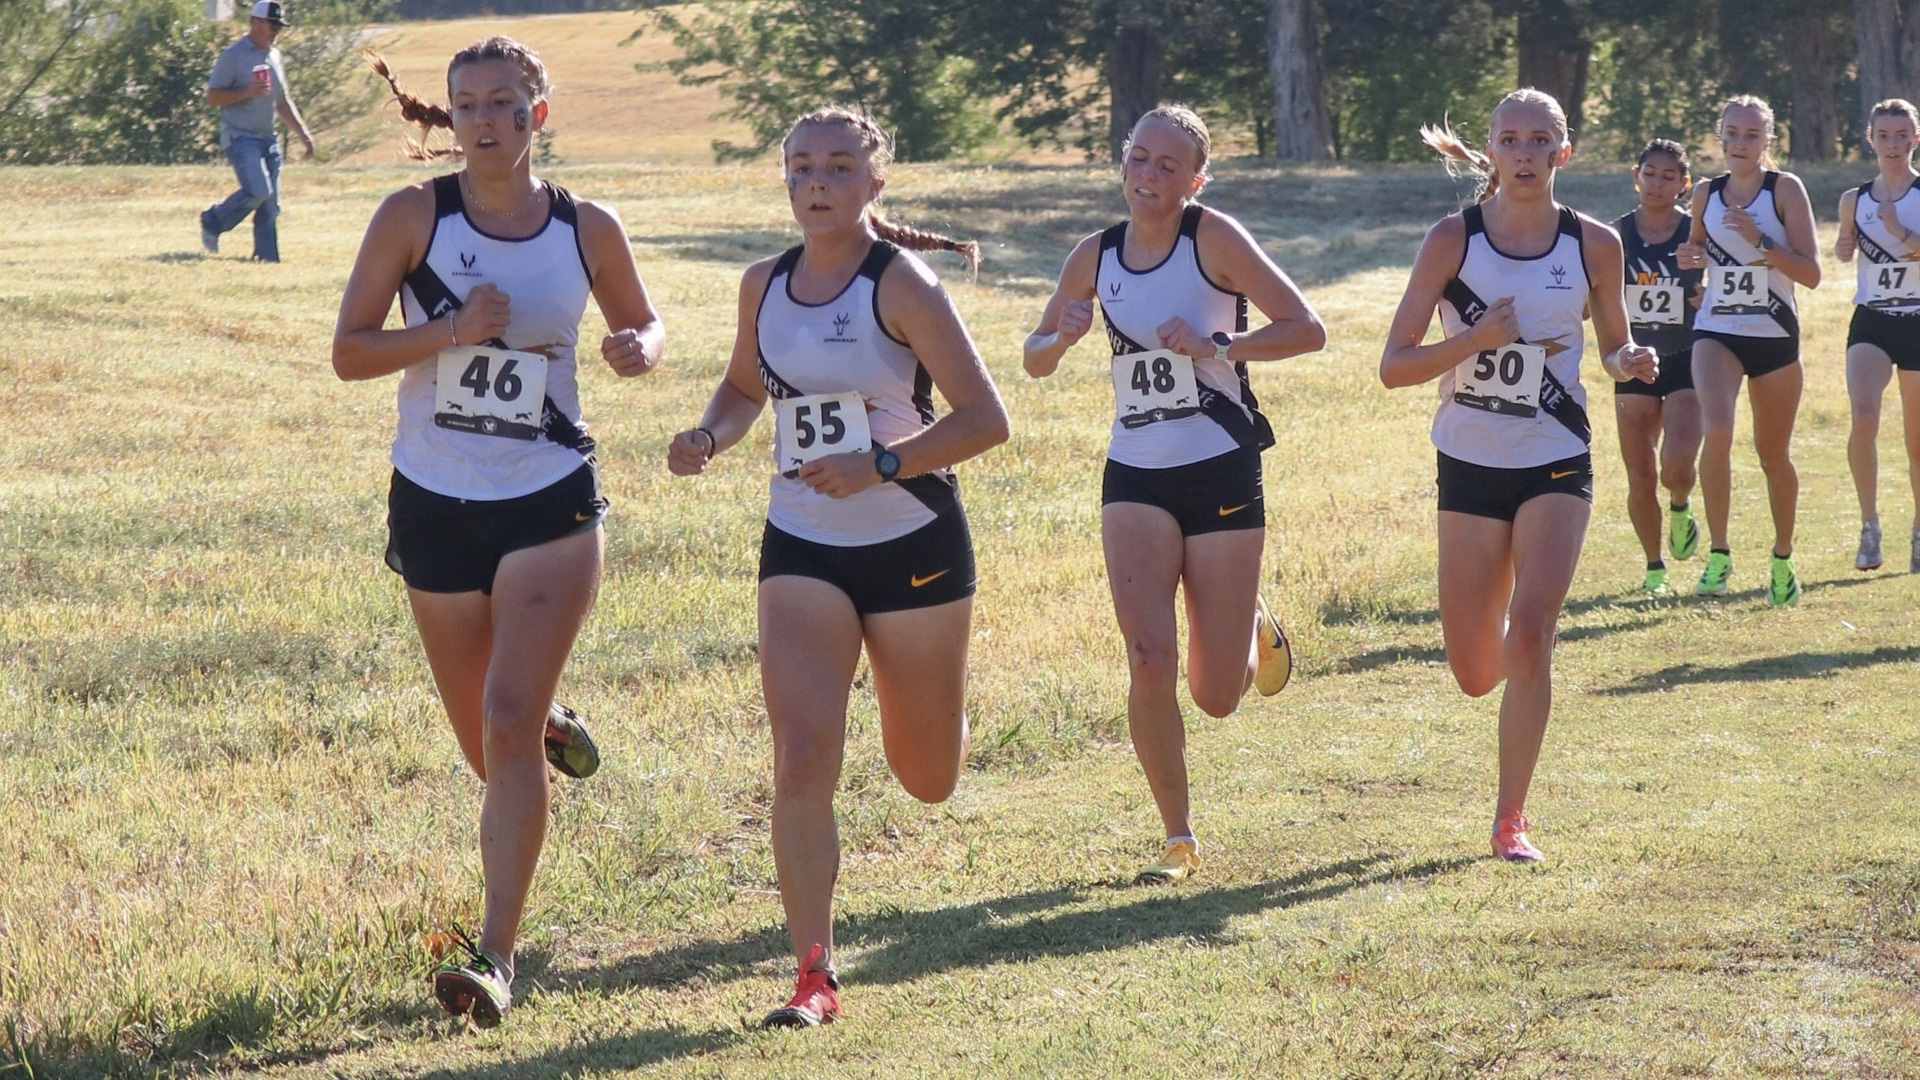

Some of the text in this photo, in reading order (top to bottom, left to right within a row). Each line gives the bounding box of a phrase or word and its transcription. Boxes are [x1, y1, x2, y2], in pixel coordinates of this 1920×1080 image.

[1723, 271, 1755, 296] 54
[1878, 267, 1907, 290] 47
[1639, 290, 1671, 313] 62
[460, 355, 522, 402] 46
[1131, 357, 1175, 396] 48
[1473, 349, 1524, 386] 50
[795, 401, 846, 449] 55
